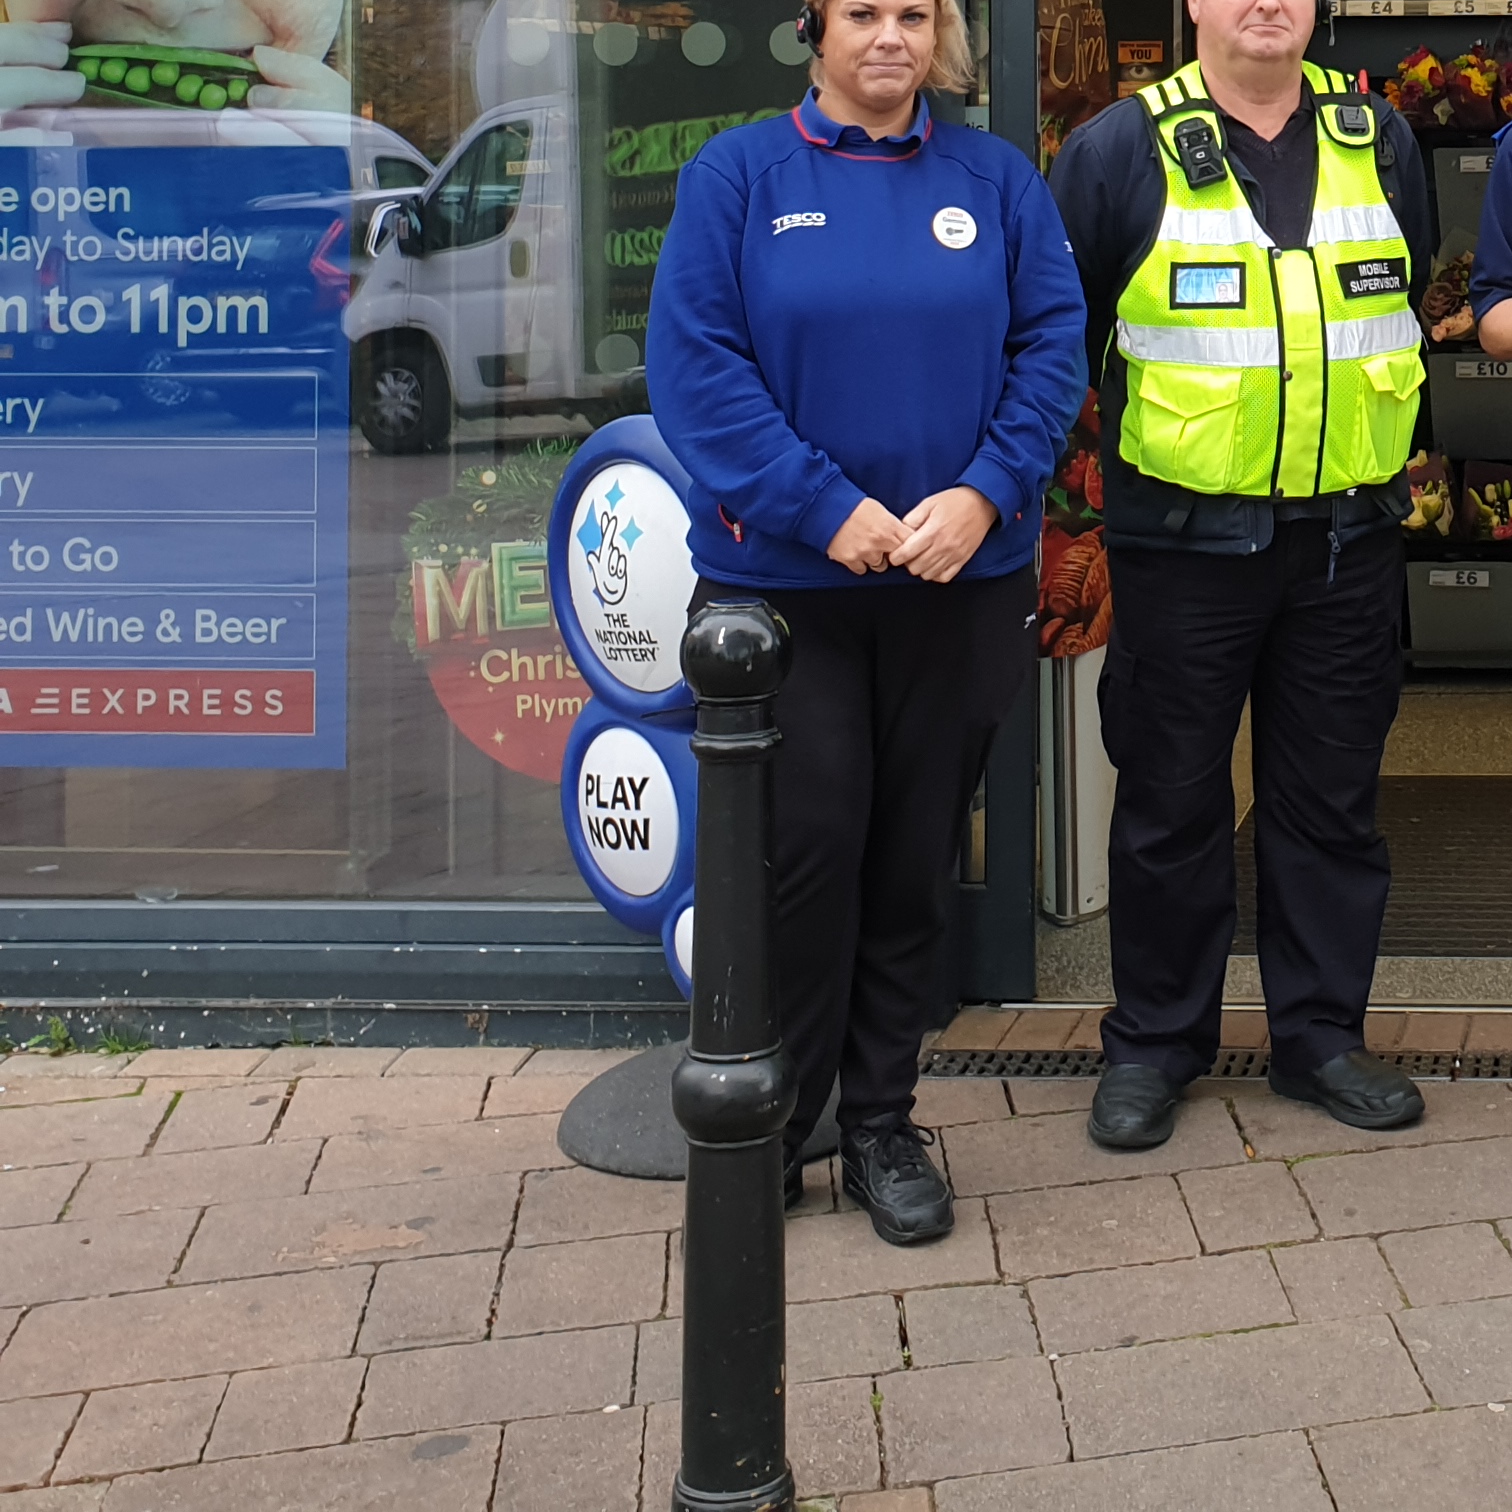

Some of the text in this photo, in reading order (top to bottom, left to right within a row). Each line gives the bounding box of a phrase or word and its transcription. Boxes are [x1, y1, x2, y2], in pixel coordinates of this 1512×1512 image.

[1371, 1, 1393, 14] £4
[1454, 1, 1475, 14] £5
[1129, 49, 1152, 60] YOU
[31, 187, 131, 222] open
[772, 212, 826, 230] TESCO
[63, 229, 102, 261] to
[115, 227, 252, 271] Sunday
[1358, 263, 1389, 276] MOBILE
[1350, 276, 1400, 293] SUPERVISOR
[44, 285, 106, 333] to
[122, 283, 269, 347] 11pm
[1476, 362, 1508, 377] £10
[0, 398, 45, 433] ry
[9, 537, 119, 573] to Go
[1455, 571, 1478, 585] £6
[46, 607, 145, 643] Wine
[156, 608, 182, 643] &
[195, 609, 287, 643] Beer
[604, 613, 630, 629] THE
[594, 628, 658, 646] NATIONAL
[602, 645, 657, 662] LOTTERY
[516, 693, 590, 723] Plym
[585, 774, 650, 811] PLAY
[588, 816, 650, 852] NOW
